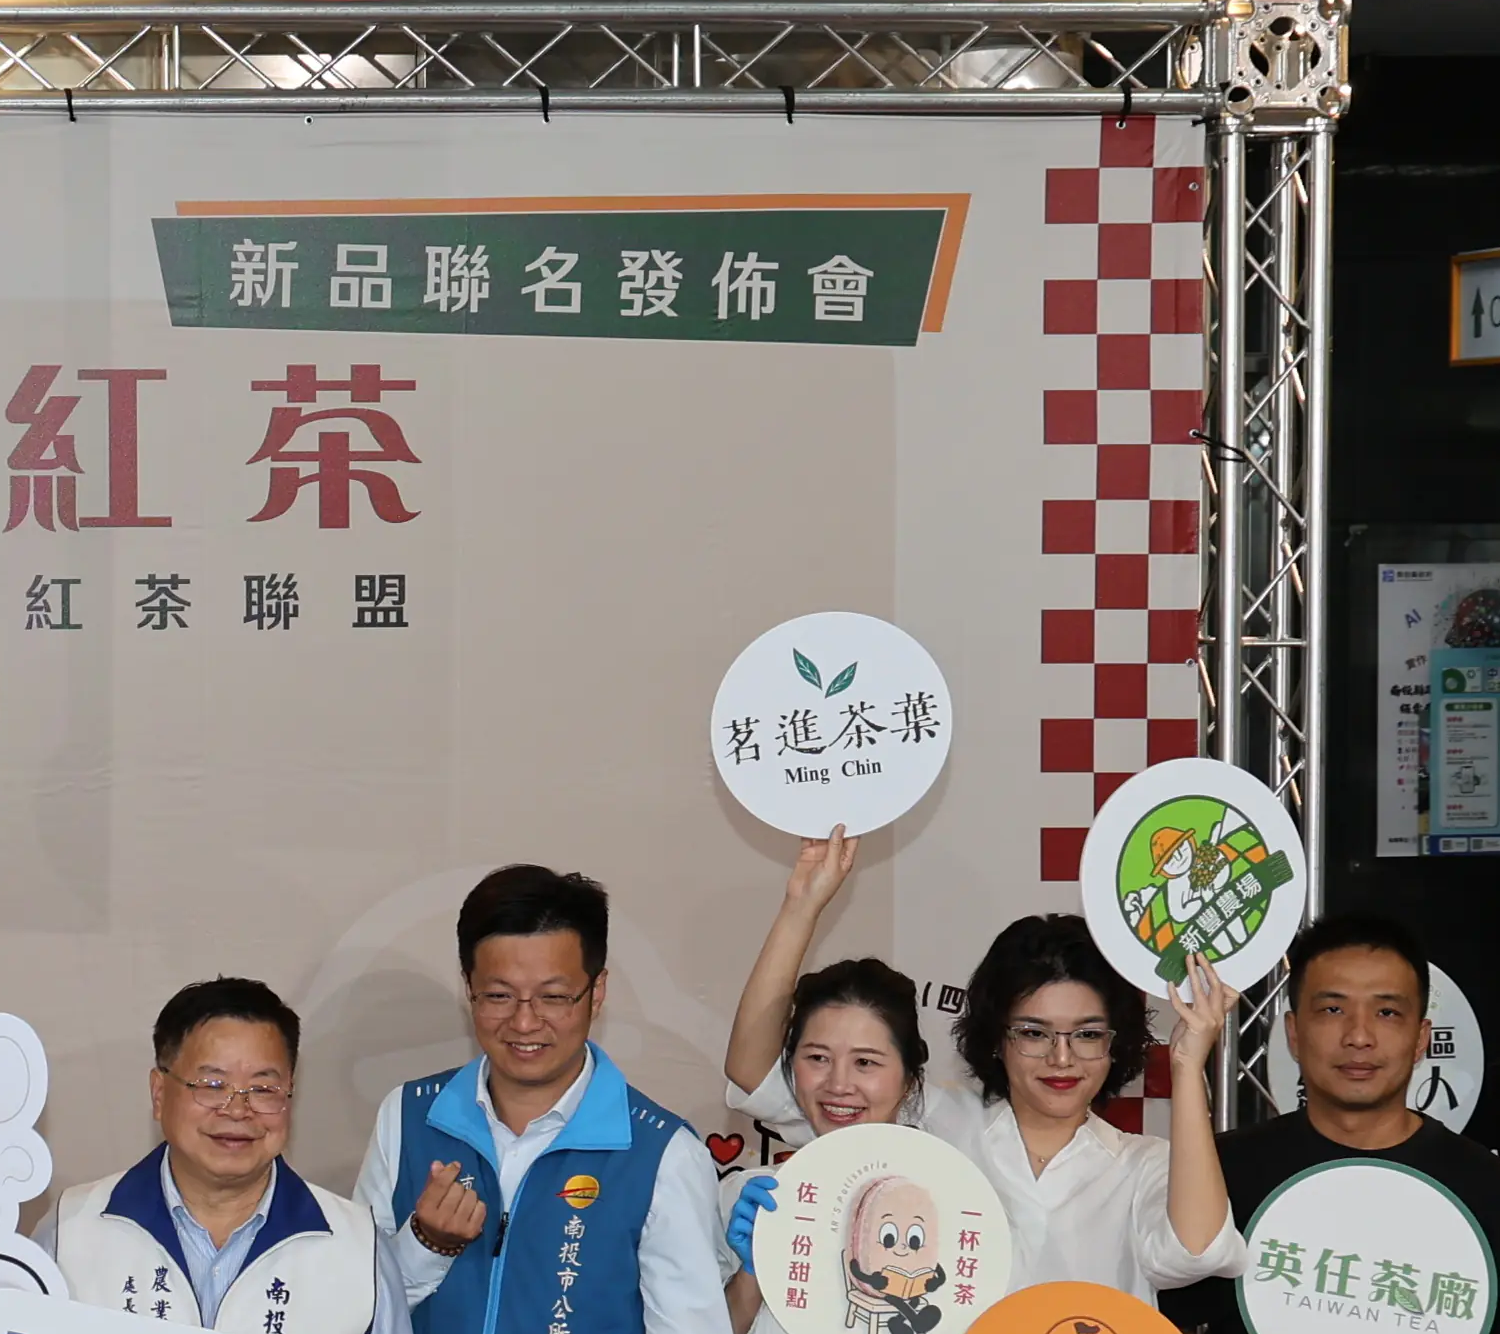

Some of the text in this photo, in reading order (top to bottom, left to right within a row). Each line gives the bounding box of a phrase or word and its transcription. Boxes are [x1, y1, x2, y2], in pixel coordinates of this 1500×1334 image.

[228, 237, 876, 323] 新品聯名發佈會
[722, 691, 942, 767] 茗進茶葉
[784, 755, 883, 786] Ming Chin
[1178, 872, 1263, 955] 新豐農場
[785, 1181, 819, 1310] 佐一份甜點
[952, 1208, 983, 1307] 一杯好茶
[1253, 1238, 1480, 1321] 英任茶廠
[122, 1275, 139, 1315] 處長
[1282, 1291, 1440, 1334] TAIWAN TEA
